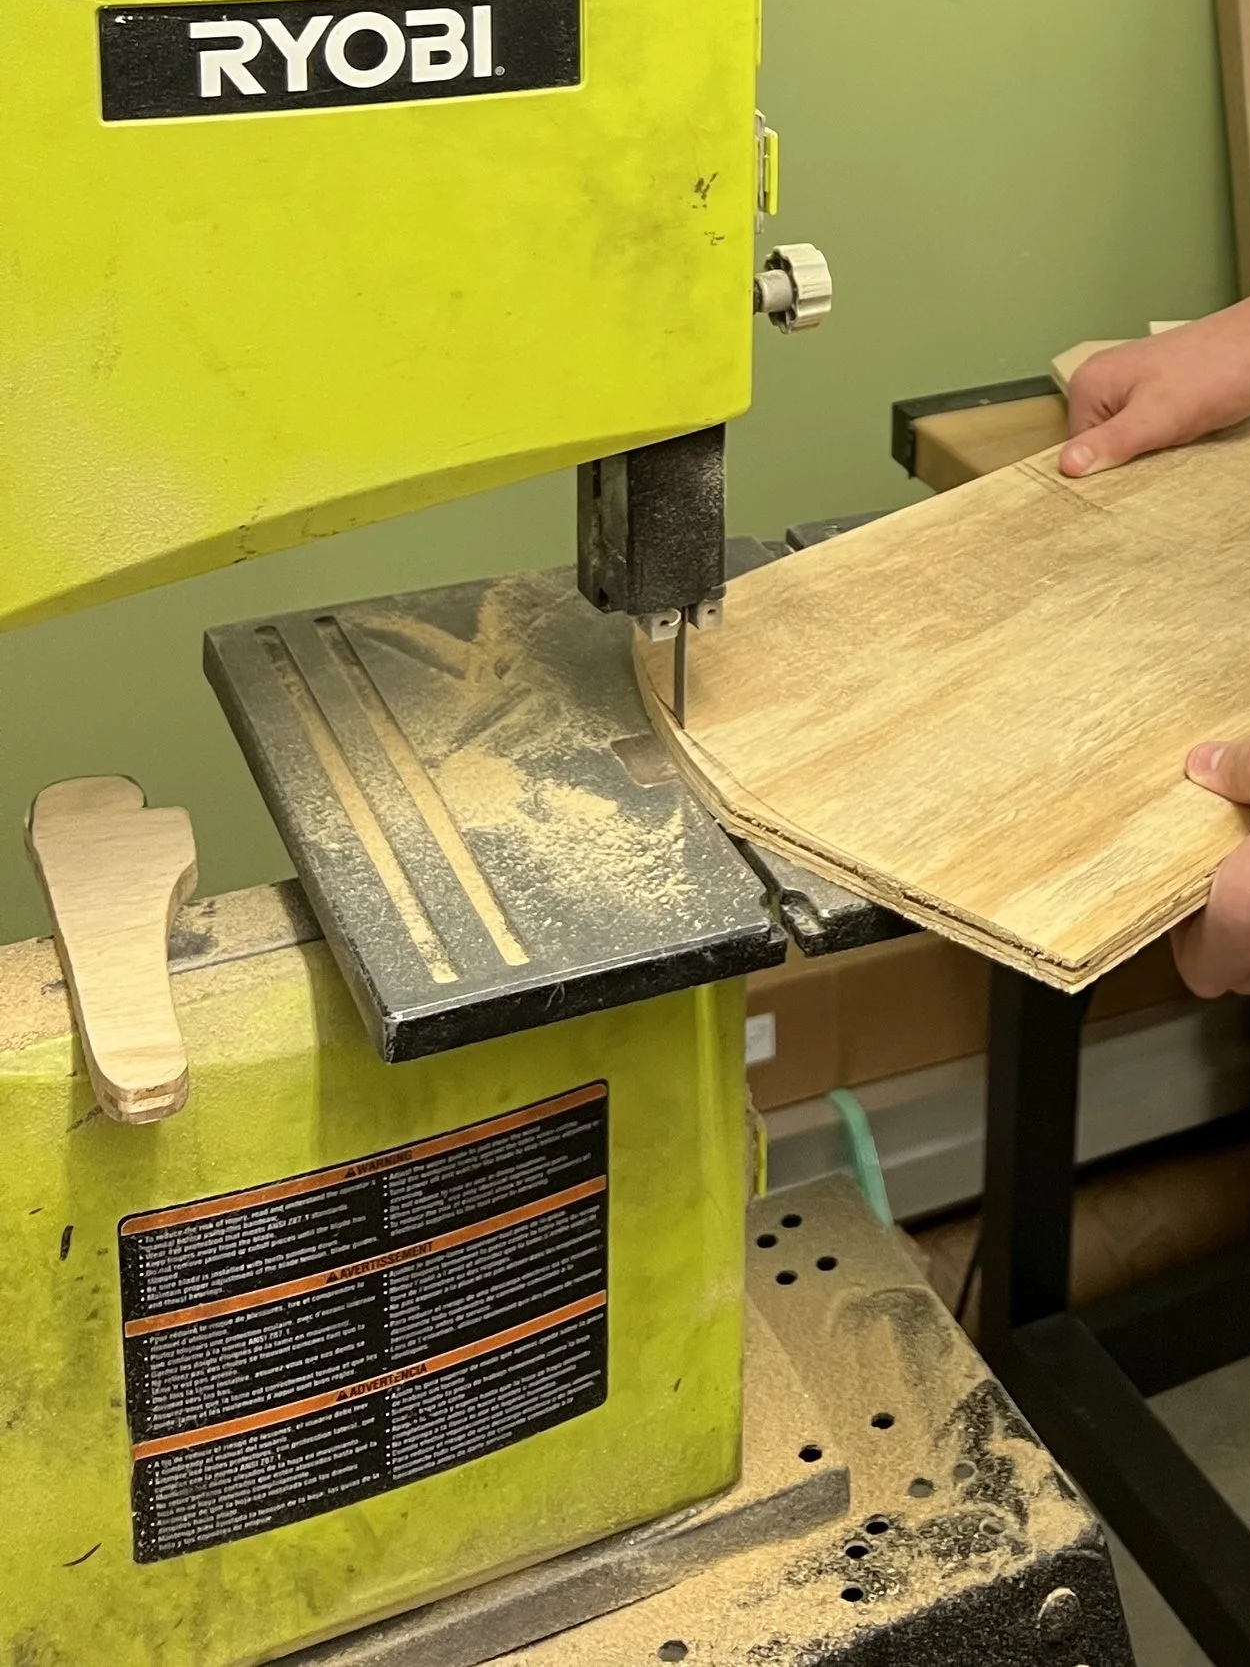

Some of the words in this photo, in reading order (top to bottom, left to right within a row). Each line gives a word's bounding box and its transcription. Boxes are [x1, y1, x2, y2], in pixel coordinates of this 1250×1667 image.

[188, 3, 493, 98] RYOBI
[356, 1149, 414, 1175] WARNING
[339, 1241, 434, 1280] AVERTISSEMENT
[350, 1362, 428, 1398] ADVERTENCIA
